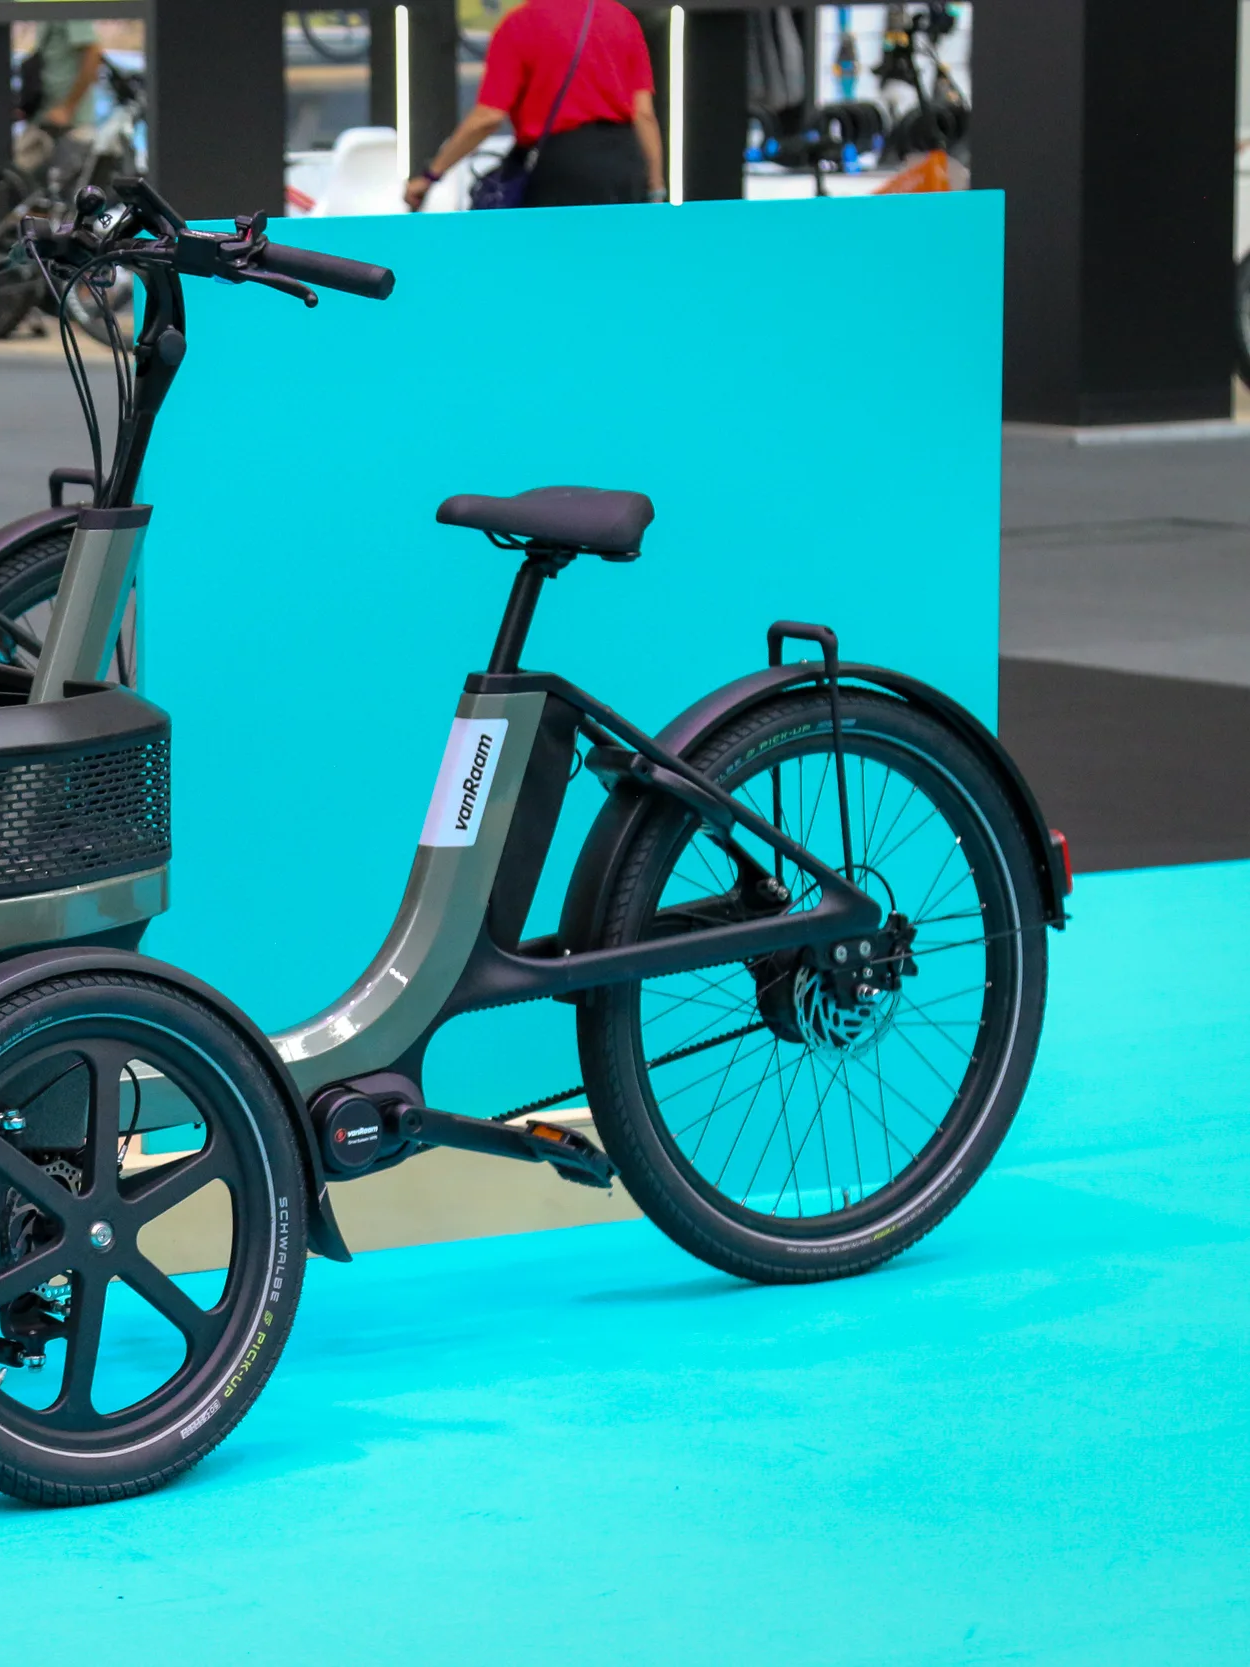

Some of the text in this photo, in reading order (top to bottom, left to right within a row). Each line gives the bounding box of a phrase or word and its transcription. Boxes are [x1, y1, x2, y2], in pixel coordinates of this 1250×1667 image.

[455, 733, 493, 831] vanRaam
[759, 724, 811, 750] PICK-UP
[224, 1197, 289, 1398] SCHWALBE PICK-UP
